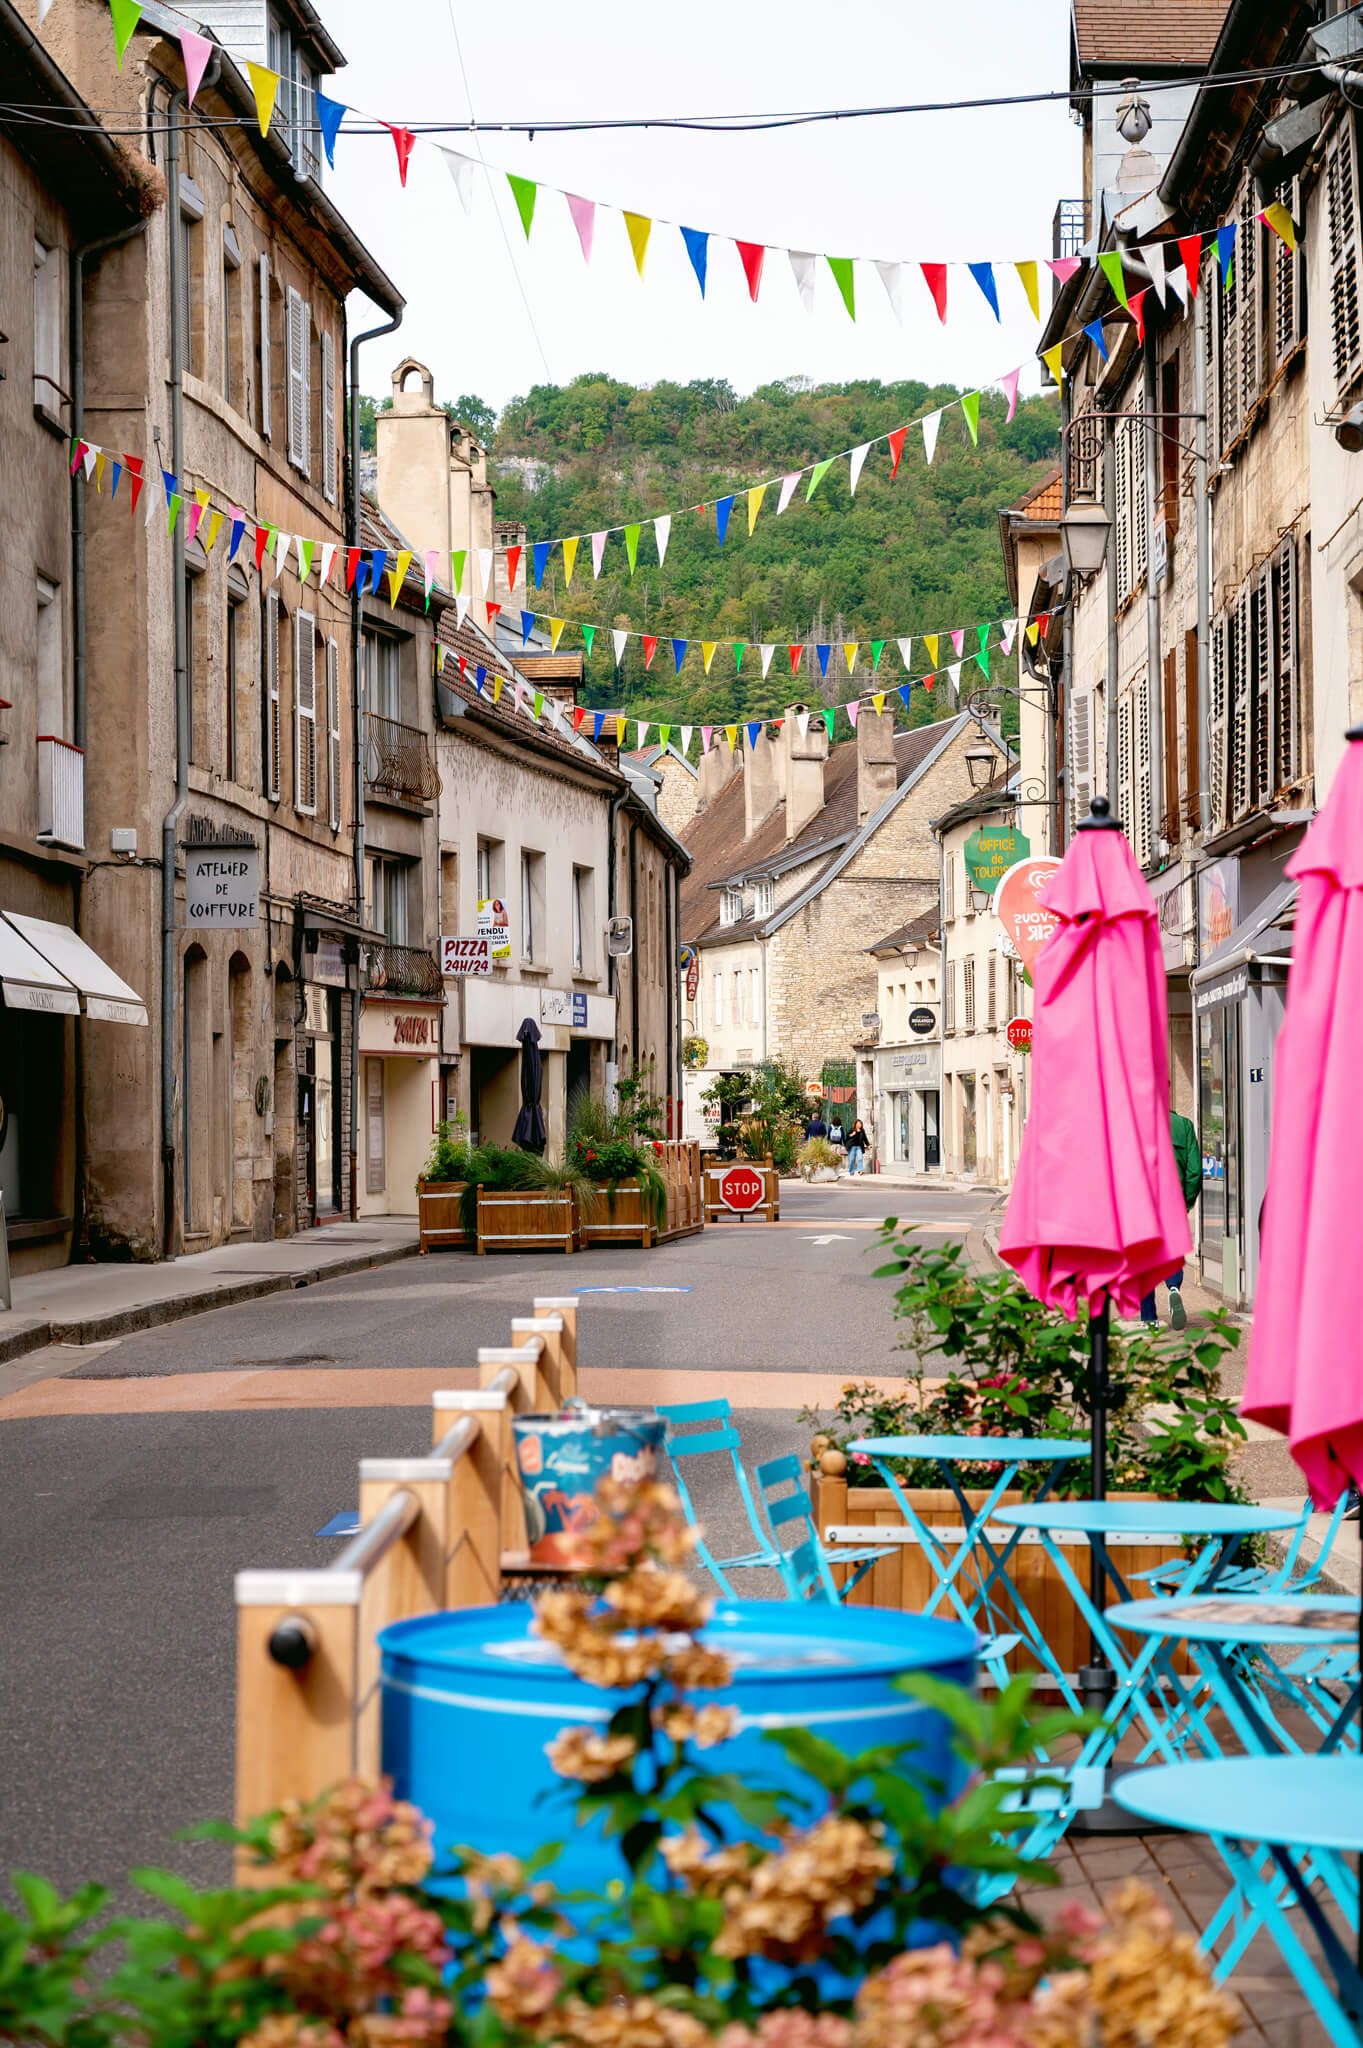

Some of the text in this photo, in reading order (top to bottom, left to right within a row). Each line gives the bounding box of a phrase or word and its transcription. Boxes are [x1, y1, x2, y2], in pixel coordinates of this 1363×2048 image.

[979, 838, 1016, 852] OFFICE
[991, 853, 1004, 865] de
[215, 883, 229, 896] DE
[444, 939, 489, 957] PIZZA
[444, 959, 489, 972] 24H/24
[688, 957, 698, 1000] TABAC
[1009, 1027, 1033, 1039] STOP
[724, 1182, 760, 1196] STOP
